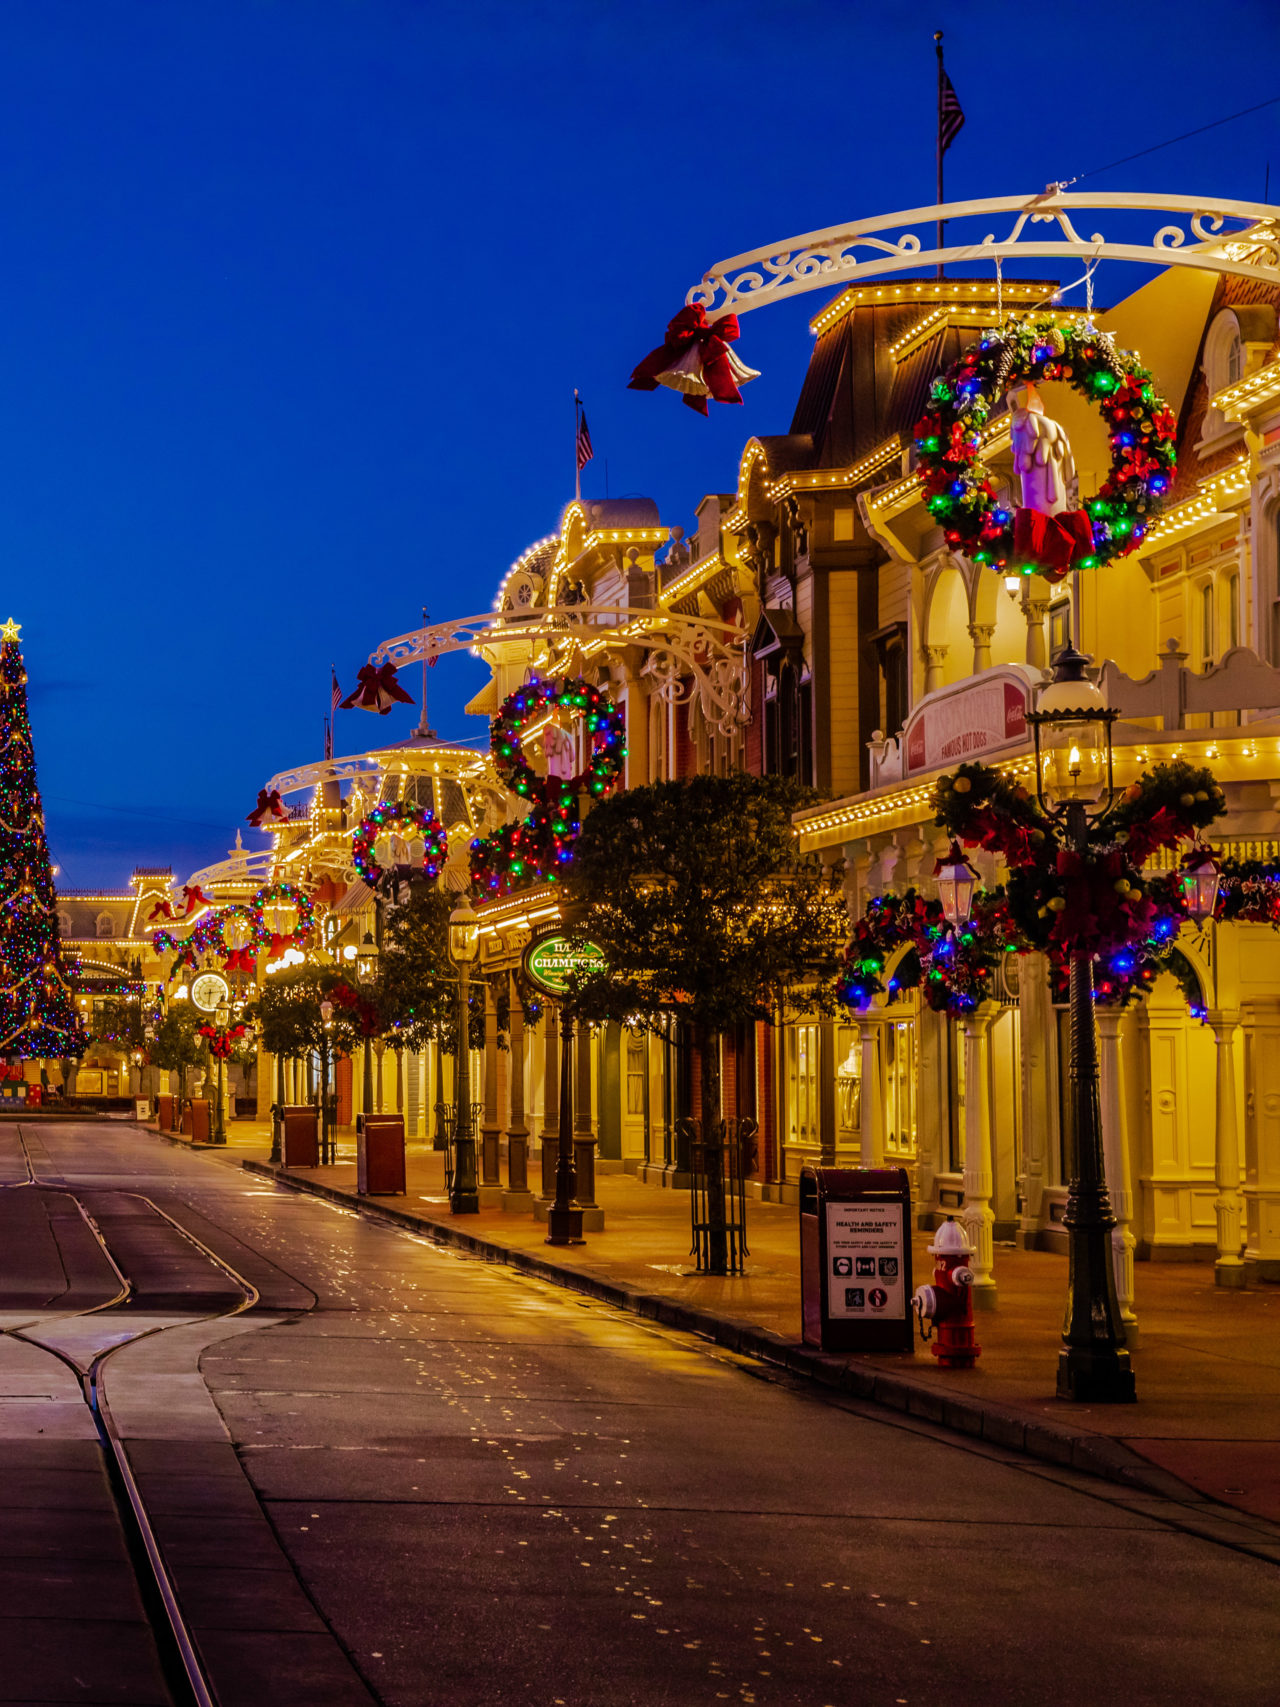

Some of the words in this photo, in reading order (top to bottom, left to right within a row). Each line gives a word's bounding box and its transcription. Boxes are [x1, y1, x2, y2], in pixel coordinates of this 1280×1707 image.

[941, 736, 962, 760] FAMOUS
[962, 732, 973, 753] HOT
[973, 731, 987, 749] DOGS
